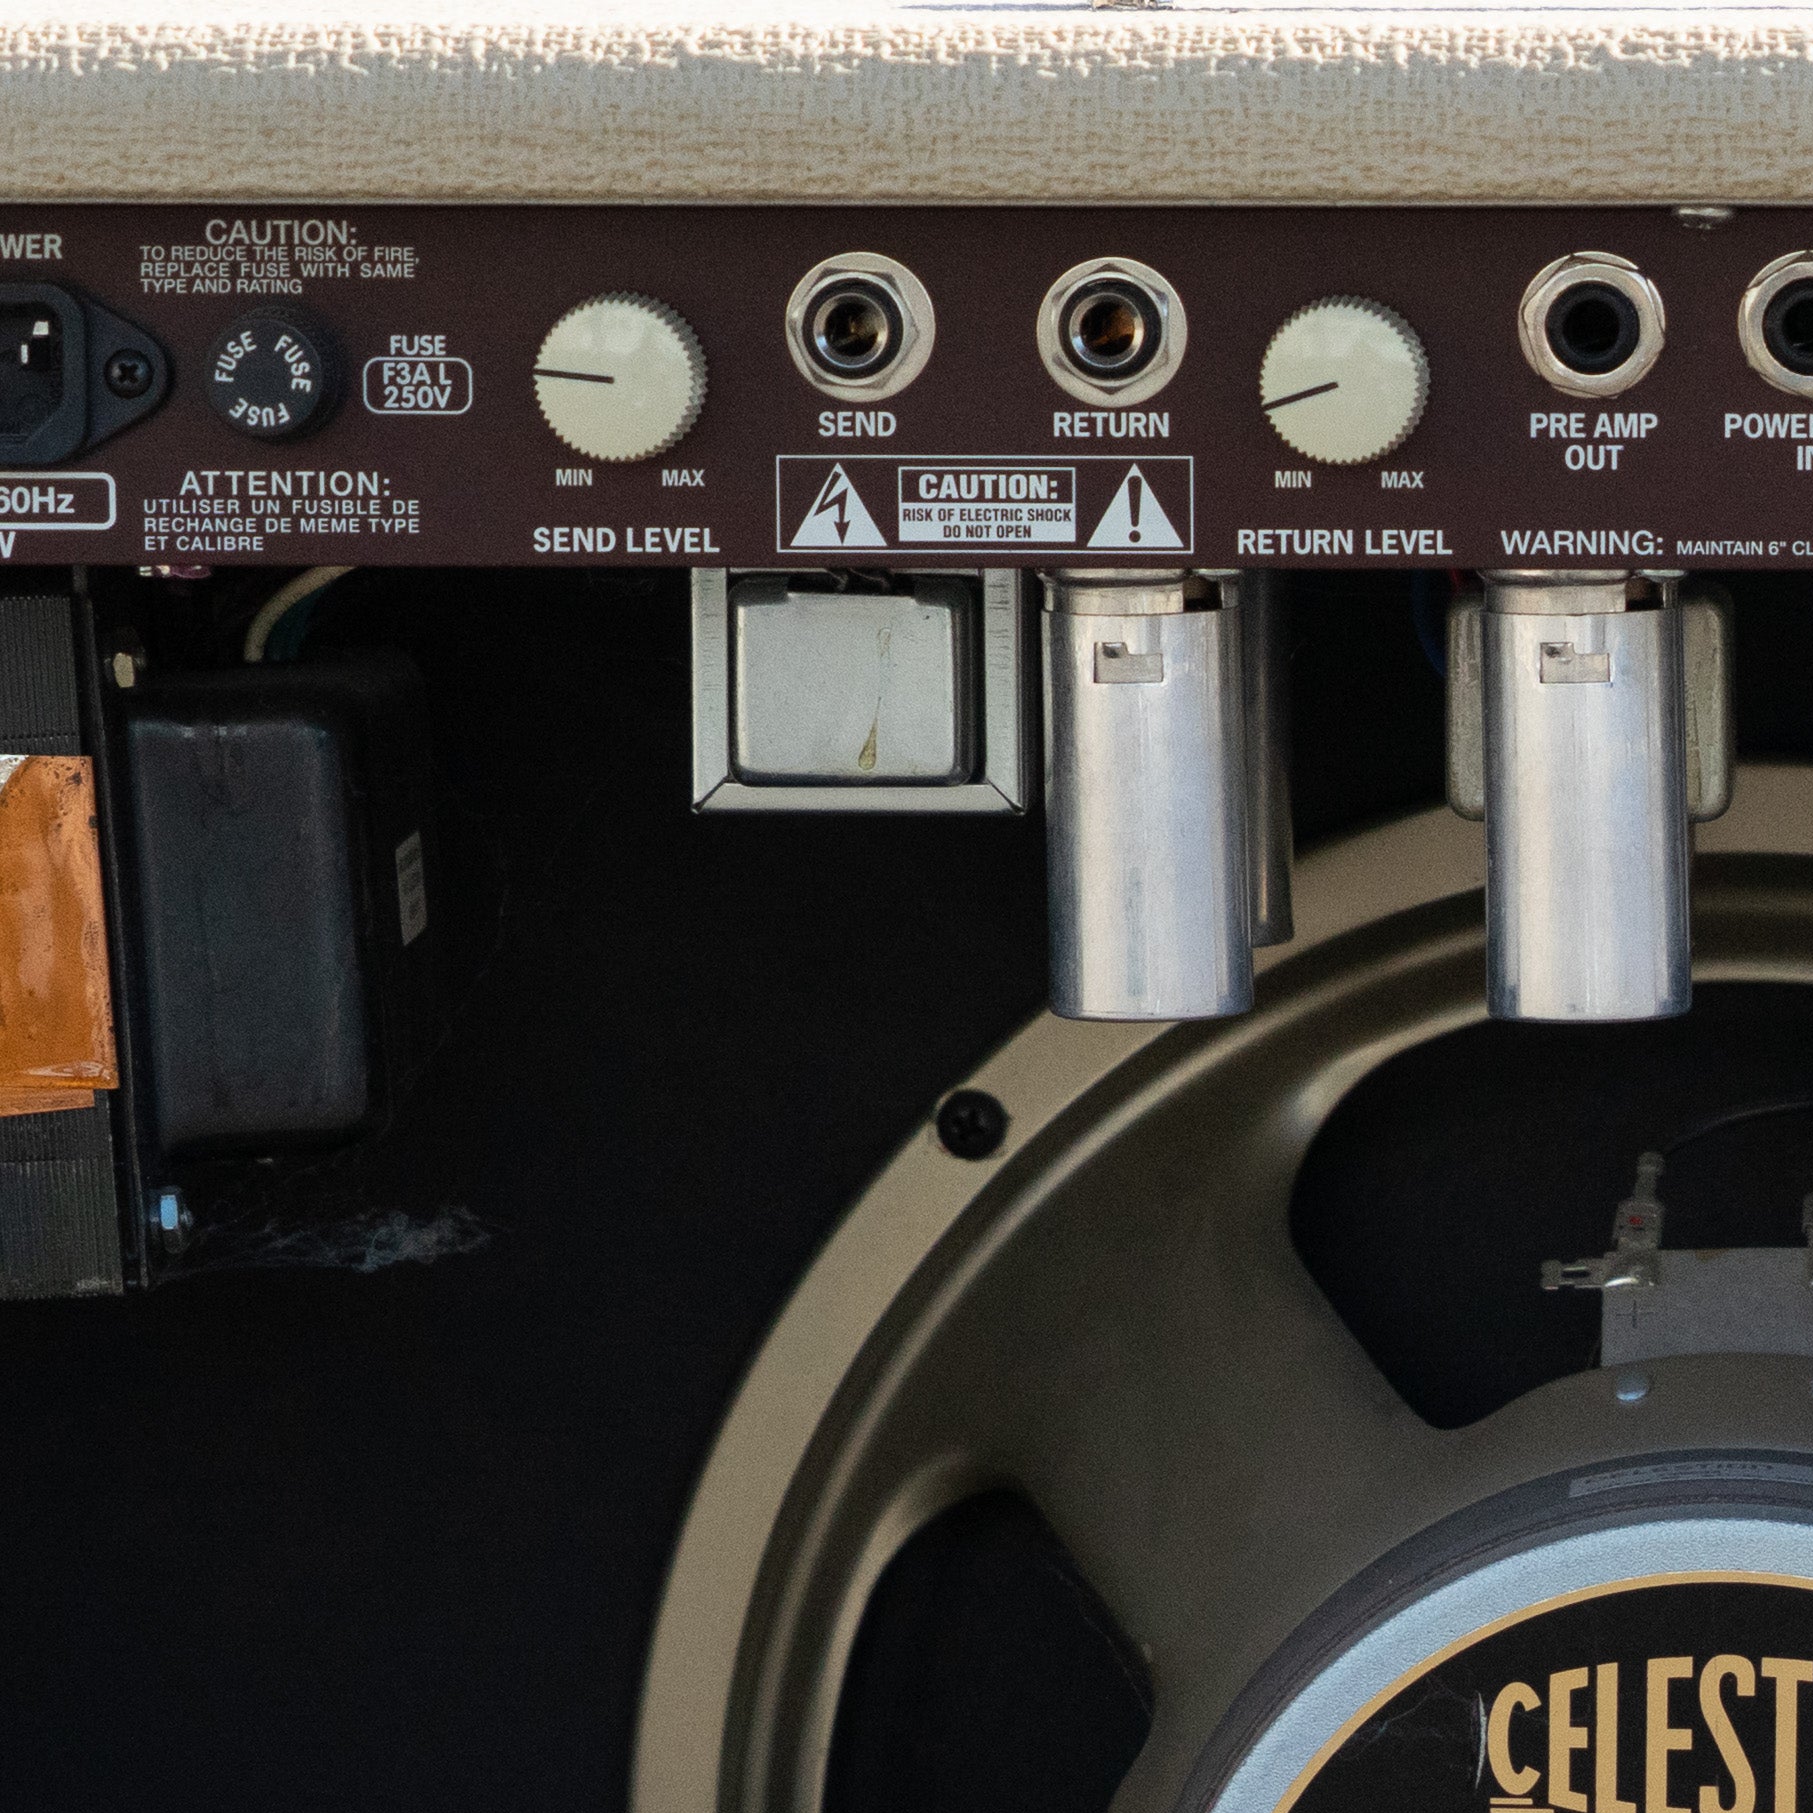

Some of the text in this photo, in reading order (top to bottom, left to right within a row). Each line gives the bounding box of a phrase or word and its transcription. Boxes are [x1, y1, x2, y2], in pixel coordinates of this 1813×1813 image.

[205, 218, 357, 246] CAUTION:
[139, 246, 420, 264] TO REDUCE THE RISK OF FIRE,
[140, 262, 415, 278] REPLACE FUSE WITH SAME
[140, 279, 303, 295] TYPE AND RATING
[215, 331, 257, 383] FUSE
[389, 334, 447, 357] FUSE
[273, 335, 312, 392] FUSE
[382, 361, 453, 386] F3A L
[384, 385, 452, 409] 250V
[228, 398, 290, 427] FUSE
[818, 410, 897, 438] SEND
[1053, 411, 1170, 438] RETURN
[1529, 412, 1659, 439] PRE AMP
[1564, 444, 1624, 471] OUT
[179, 470, 390, 497] ATTENTION:
[555, 468, 705, 487] MIN MAX
[918, 473, 1058, 500] CAUTION:
[1274, 470, 1425, 489] MIN MAX
[143, 498, 420, 516] UTILISER UN FUSIBLE DE
[902, 507, 1072, 523] RISK OF ELECTRIC SHOCK
[143, 516, 420, 534] RECHANGE DE MEME TYPE
[942, 524, 1032, 539] DO NOT OPEN
[144, 535, 264, 552] ET CALIBRE
[533, 526, 721, 554] SEND LEVEL
[1237, 528, 1453, 555] RETURN LEVEL
[1500, 529, 1664, 556] WARNING:
[1676, 540, 1764, 556] MAINTAIN
[1767, 540, 1787, 556] 6"
